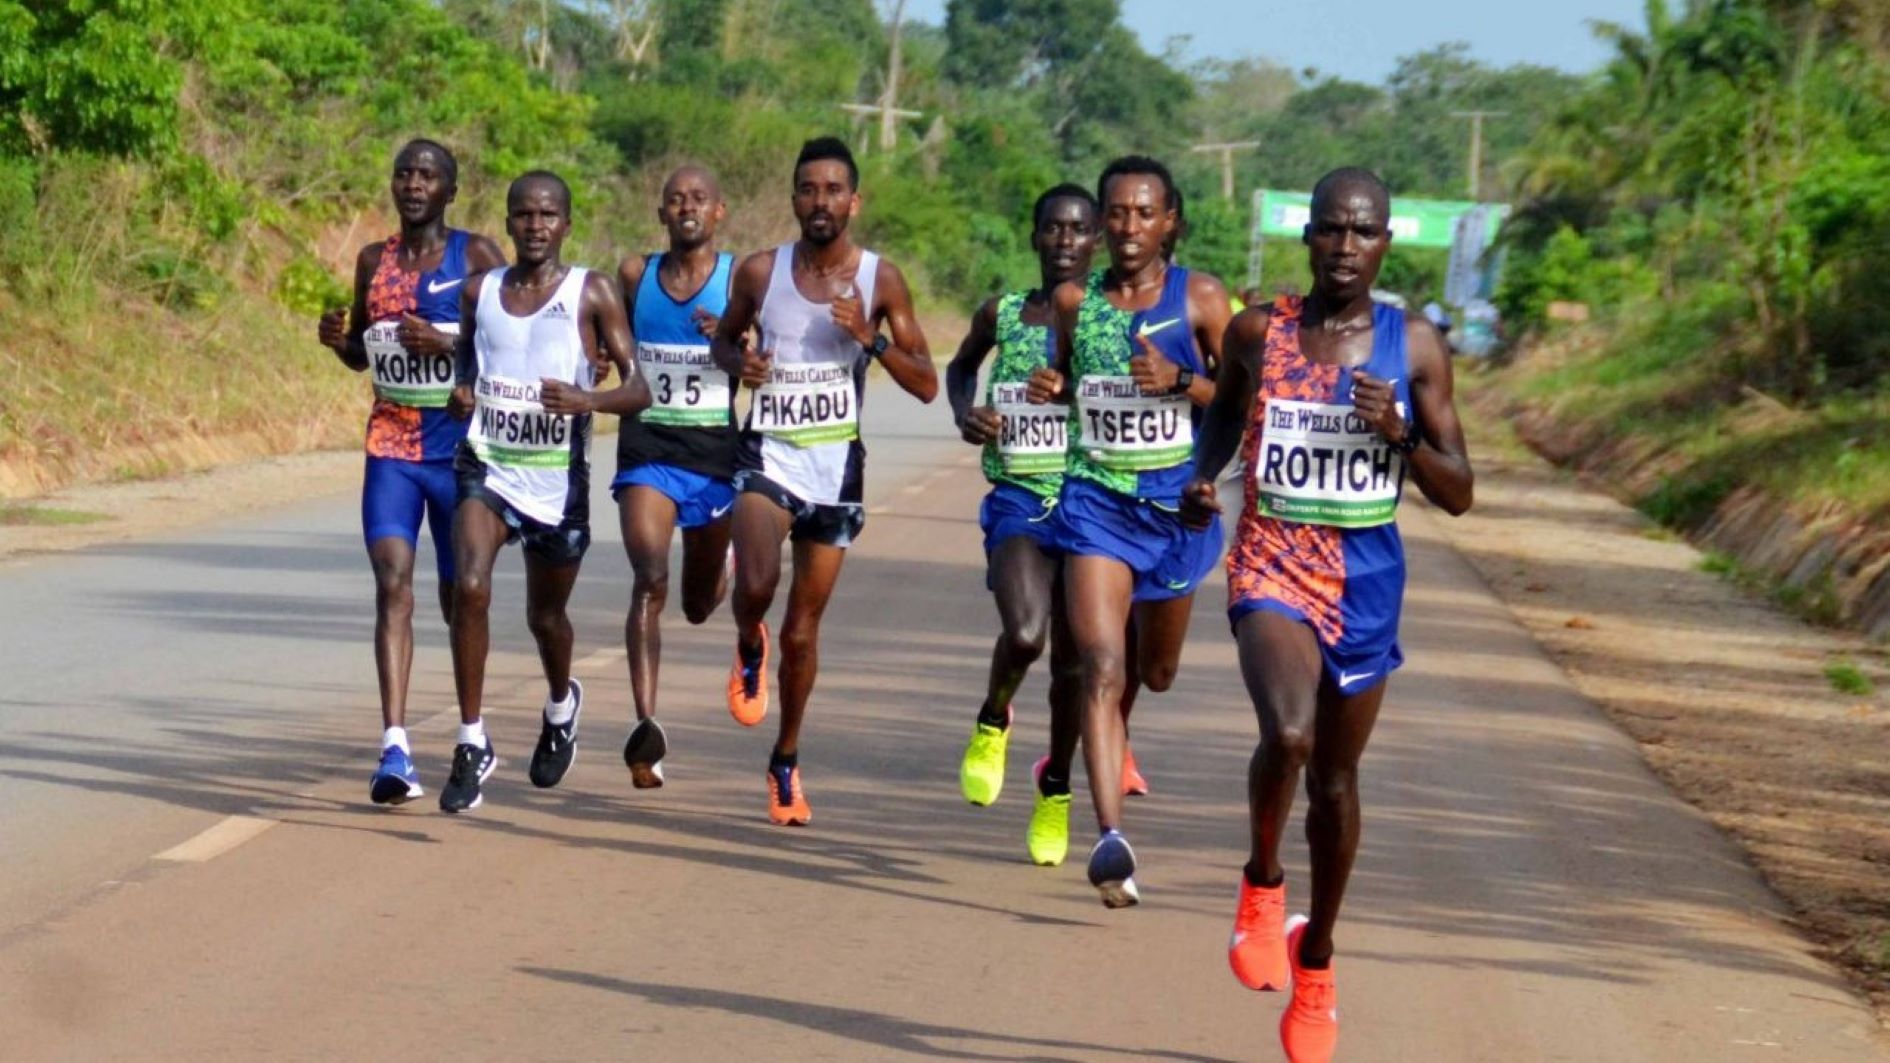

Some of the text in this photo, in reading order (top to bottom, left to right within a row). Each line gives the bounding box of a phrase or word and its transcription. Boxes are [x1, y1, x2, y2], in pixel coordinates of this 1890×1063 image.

[375, 352, 451, 384] KORIO
[654, 348, 683, 365] WELLS
[493, 380, 523, 400] WELLS
[775, 367, 806, 385] WELLS
[1081, 380, 1099, 396] THE
[1101, 380, 1137, 398] WELLS
[760, 390, 849, 425] FIKADU
[1270, 406, 1294, 428] THE
[1298, 409, 1341, 433] WELLS
[481, 404, 565, 444] KIPSANG
[1001, 415, 1066, 446] BARSOT
[1087, 408, 1177, 443] TSEGU
[1264, 443, 1392, 492] ROTICH
